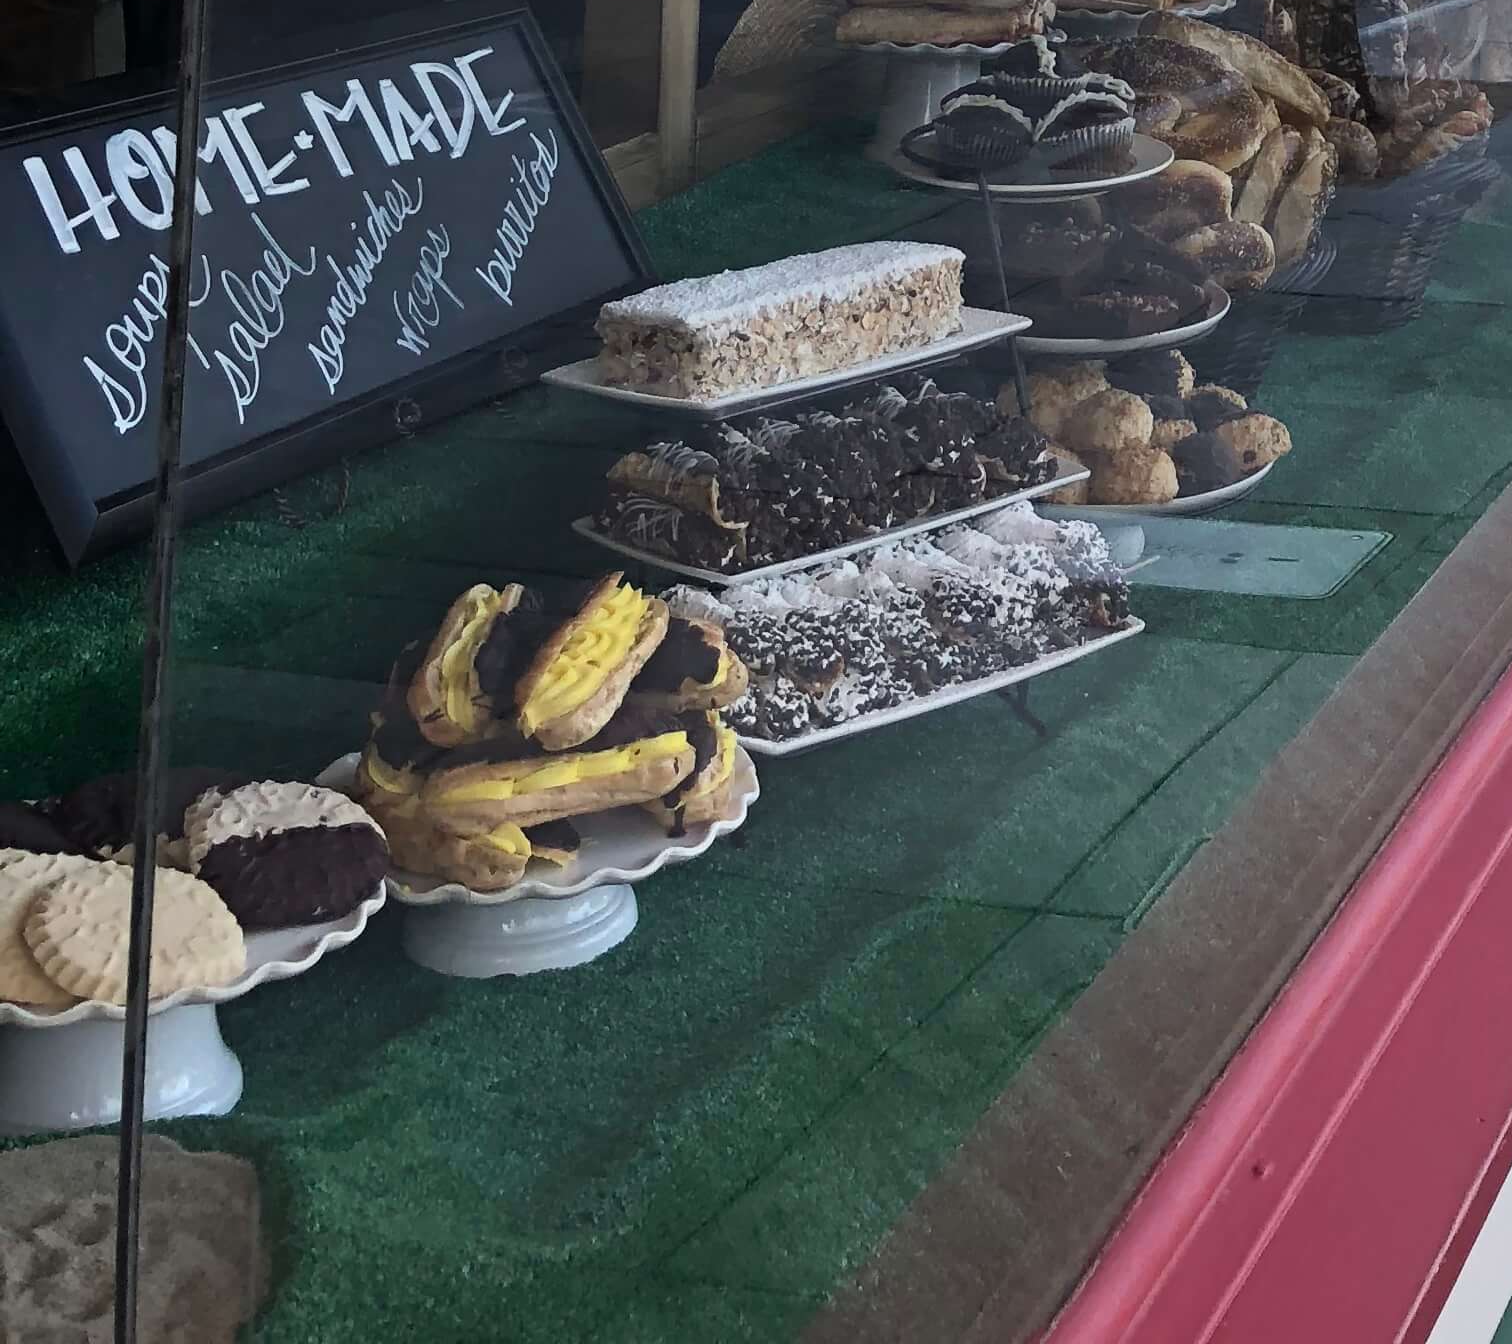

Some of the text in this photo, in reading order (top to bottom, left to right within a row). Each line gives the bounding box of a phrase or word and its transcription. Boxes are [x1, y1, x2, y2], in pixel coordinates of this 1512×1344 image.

[213, 211, 316, 425] salad
[308, 176, 424, 396] sandwiches
[475, 127, 559, 307] burritos
